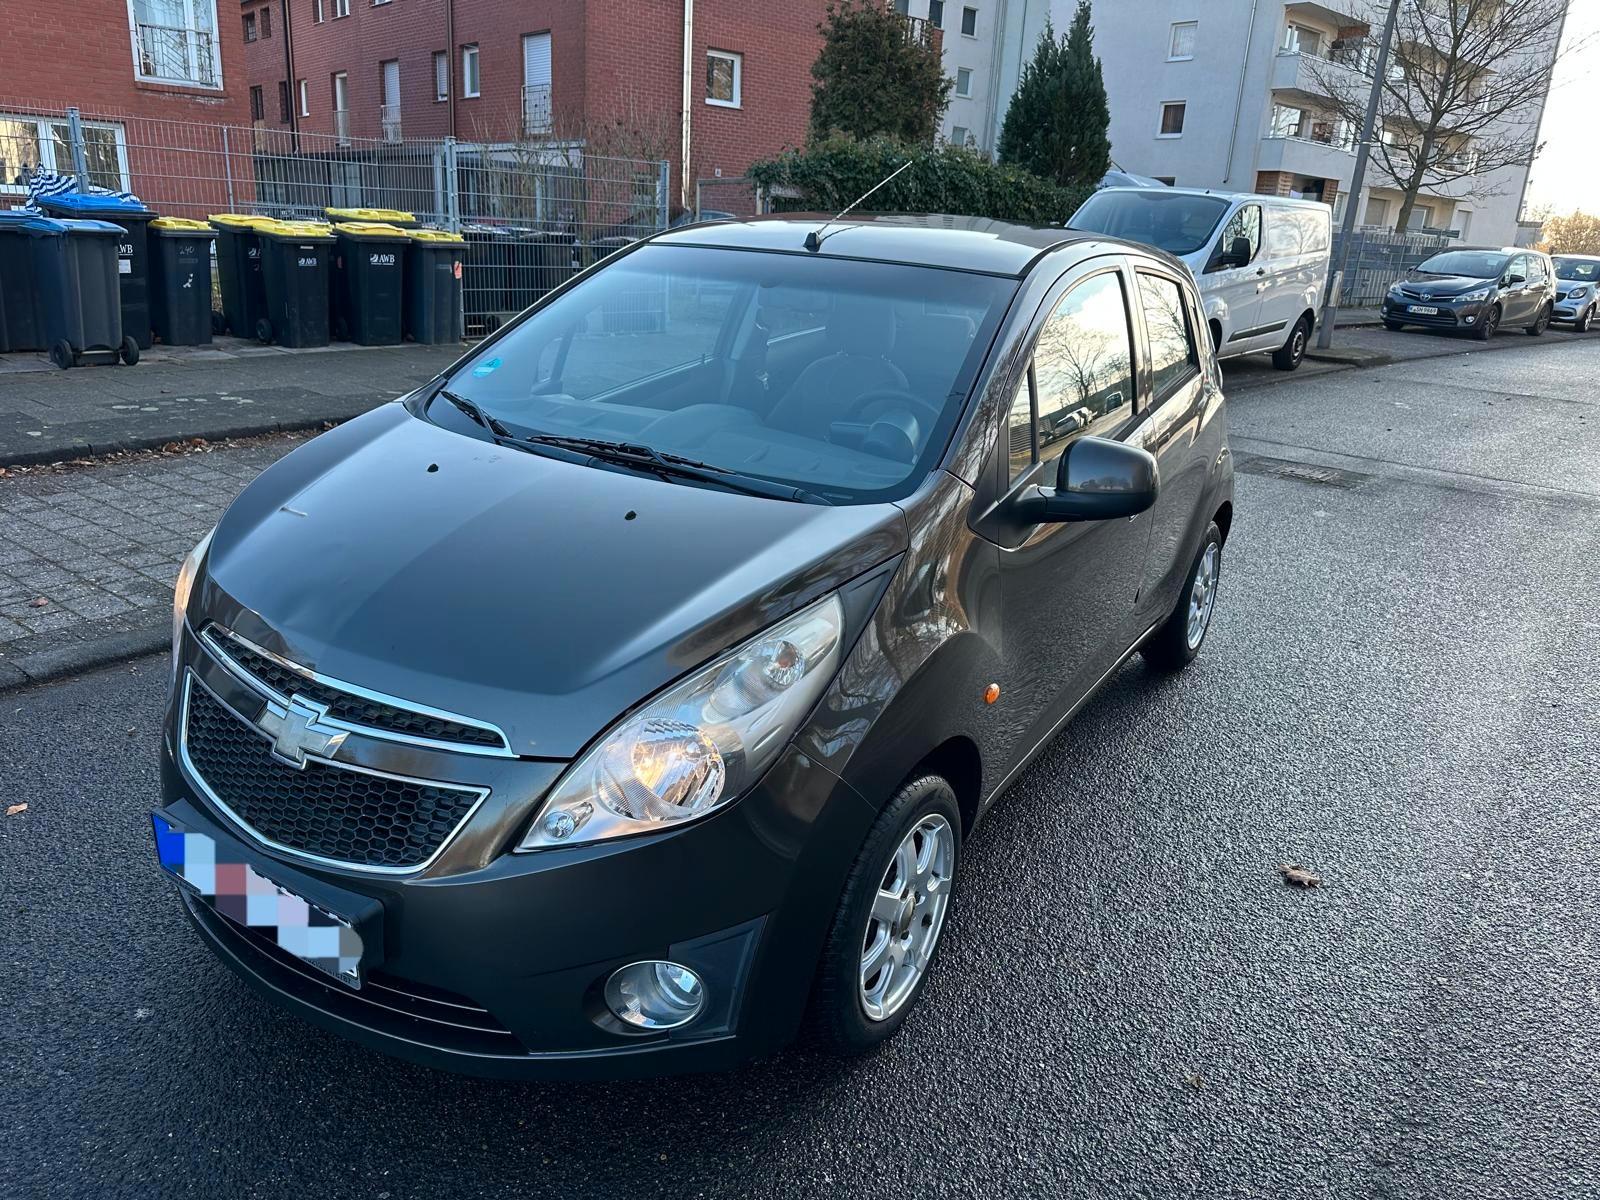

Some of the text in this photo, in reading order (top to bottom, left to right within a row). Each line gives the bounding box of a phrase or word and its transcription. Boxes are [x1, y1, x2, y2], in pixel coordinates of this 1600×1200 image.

[118, 244, 133, 254] WB
[305, 257, 317, 265] AWB
[379, 254, 395, 263] AWB
